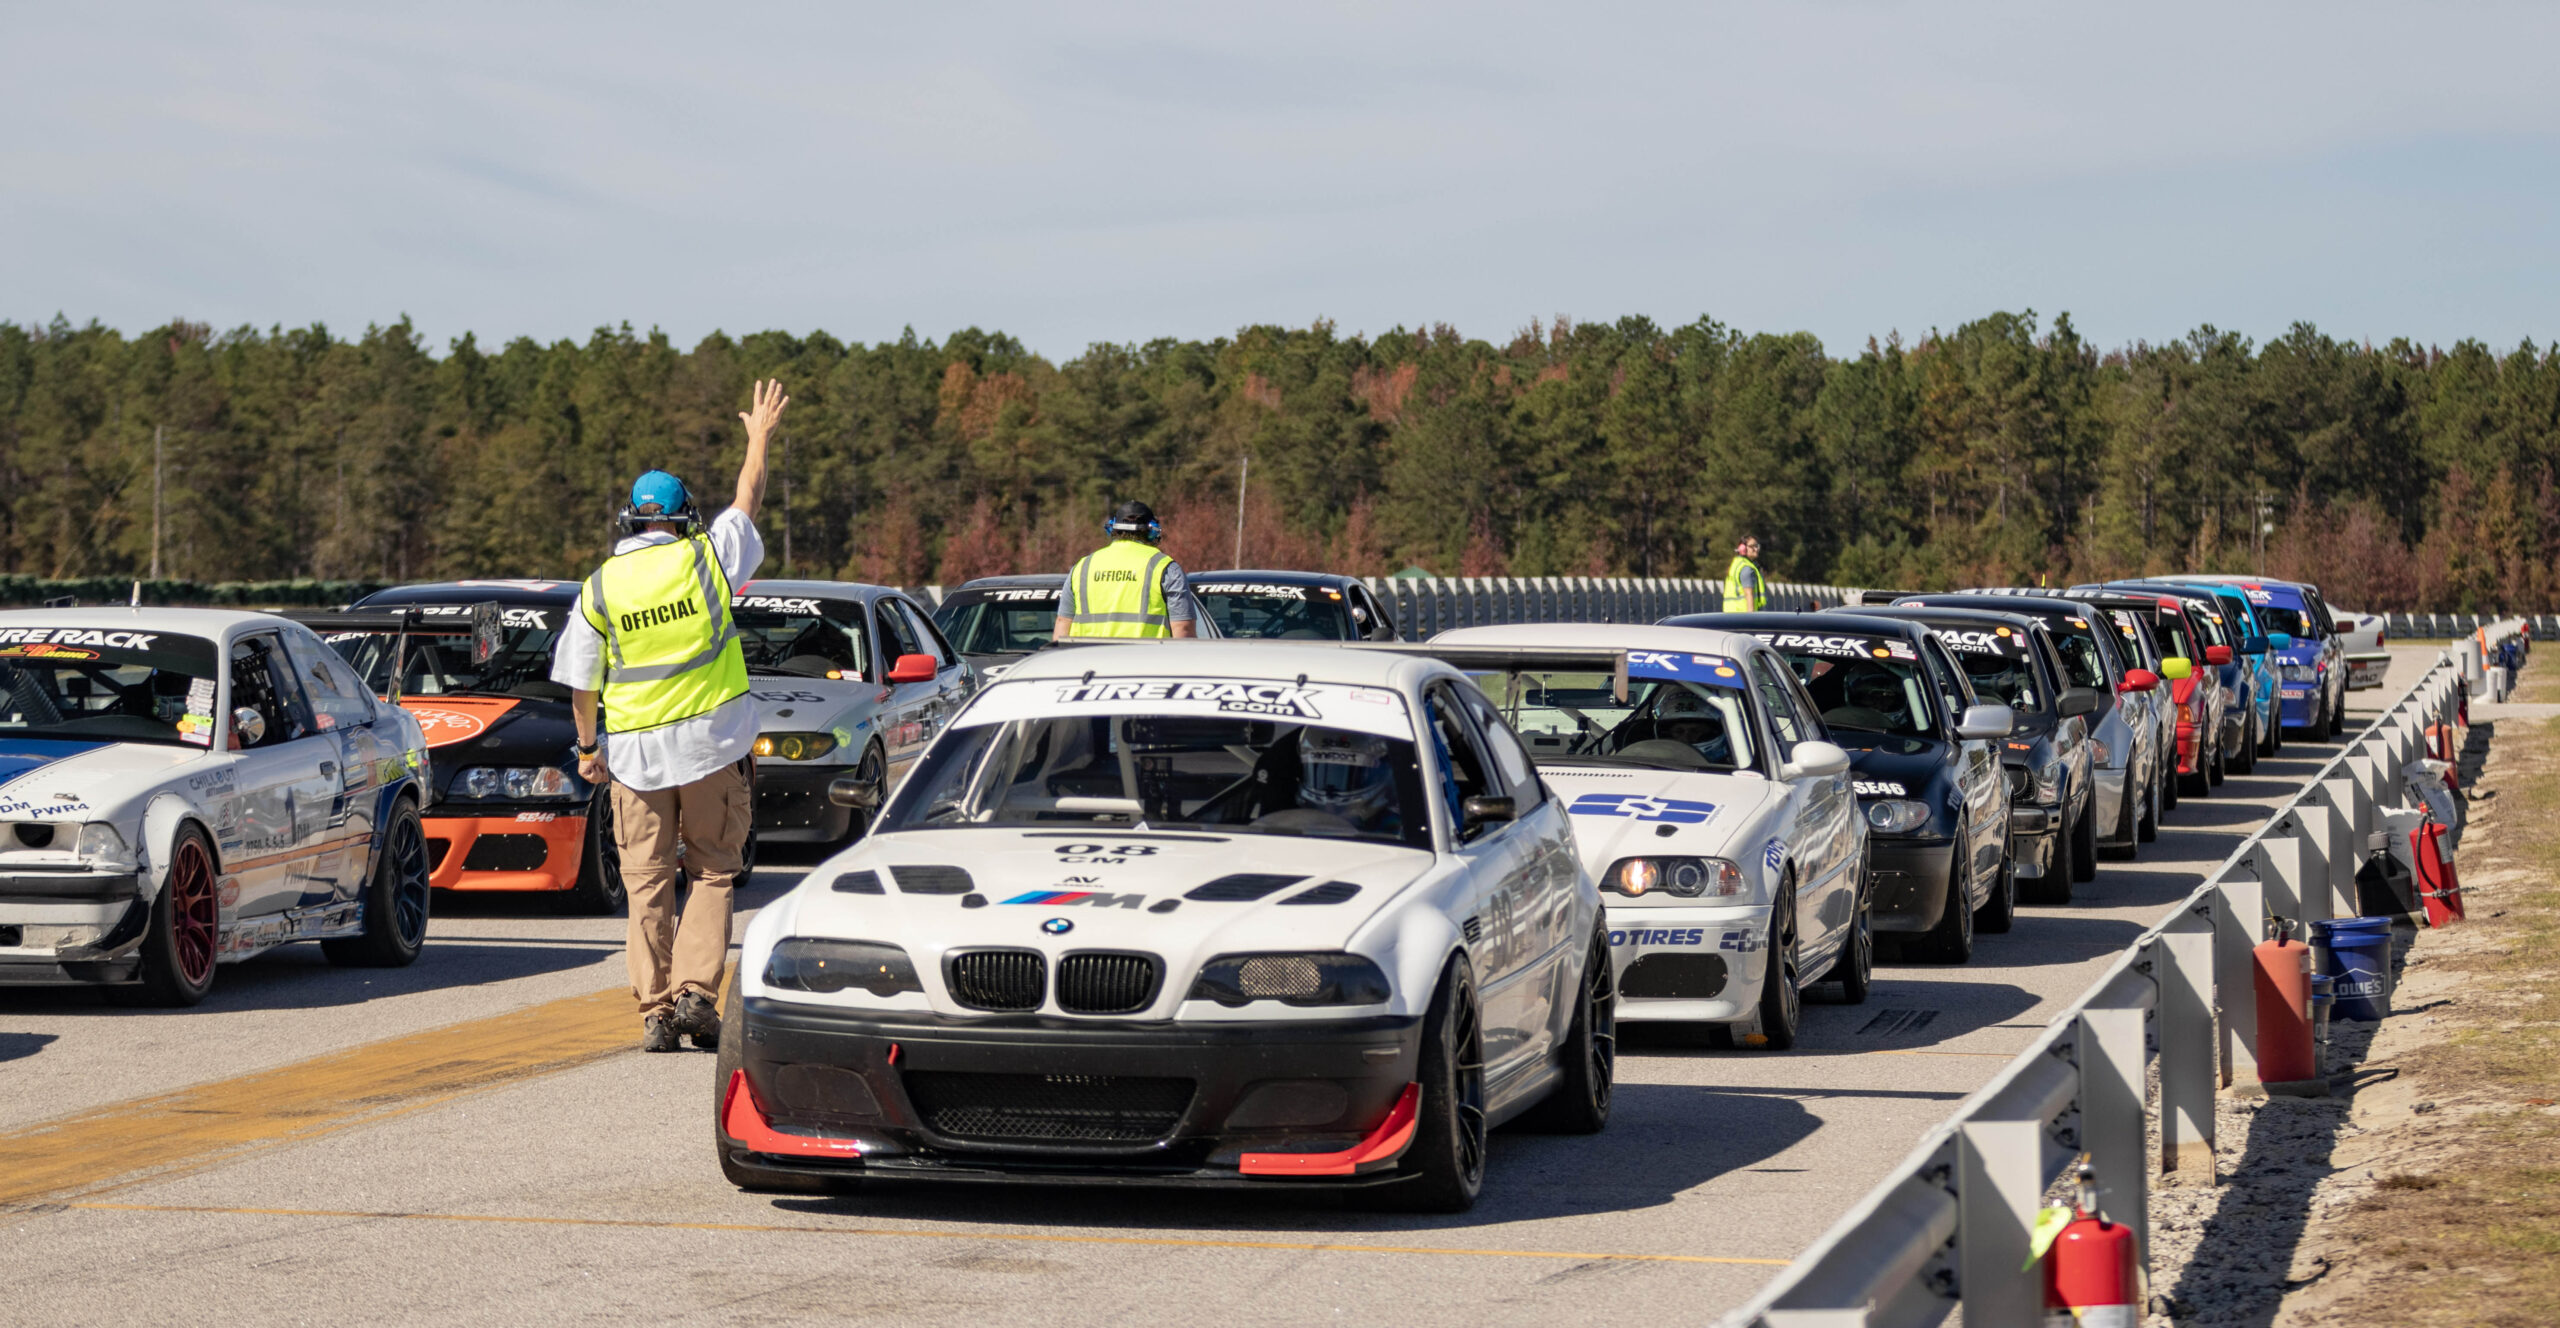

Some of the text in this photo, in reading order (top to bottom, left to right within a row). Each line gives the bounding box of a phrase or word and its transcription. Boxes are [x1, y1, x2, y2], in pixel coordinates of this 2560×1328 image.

[1094, 570, 1137, 582] OFFICIAL
[995, 590, 1049, 601] TIRE
[1197, 584, 1307, 600] TIRE RACK
[743, 597, 822, 615] RACK
[621, 598, 698, 632] OFFICIAL
[48, 629, 157, 651] RACK
[1776, 634, 1872, 659] RACK
[1807, 648, 1855, 657] .com
[1055, 683, 1323, 719] TIRE RACK
[1221, 701, 1296, 715] .com
[1851, 781, 1906, 796] SE46
[1054, 844, 1160, 856] 08
[2335, 979, 2383, 996] OWE'S
